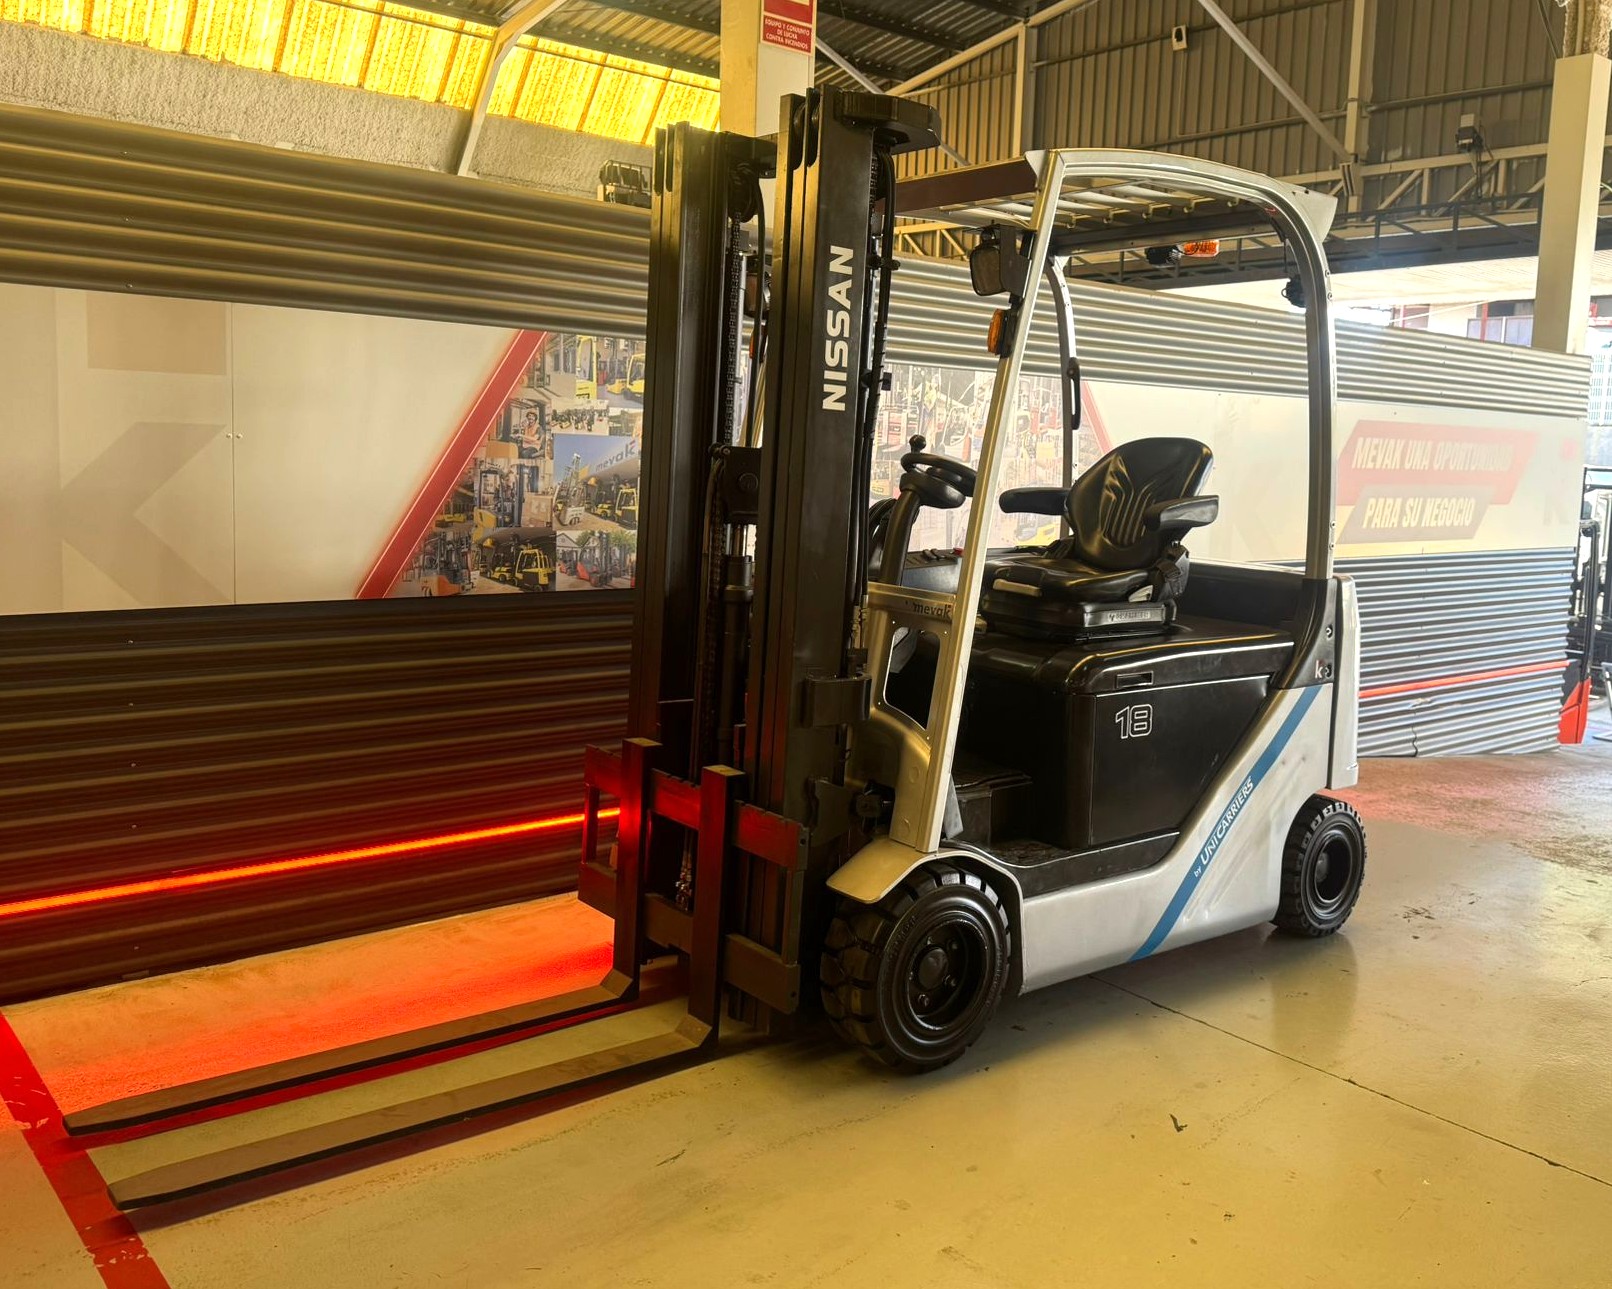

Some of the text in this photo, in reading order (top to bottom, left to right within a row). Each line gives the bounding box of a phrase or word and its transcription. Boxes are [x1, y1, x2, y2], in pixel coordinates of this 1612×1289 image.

[822, 245, 854, 411] NISSAN
[1352, 437, 1407, 469] MEVAK
[1404, 440, 1433, 470] UNA
[1362, 497, 1477, 529] PARA SU NEGOCIO
[1115, 704, 1153, 739] 18
[1194, 776, 1254, 877] by UNICARRIERS
